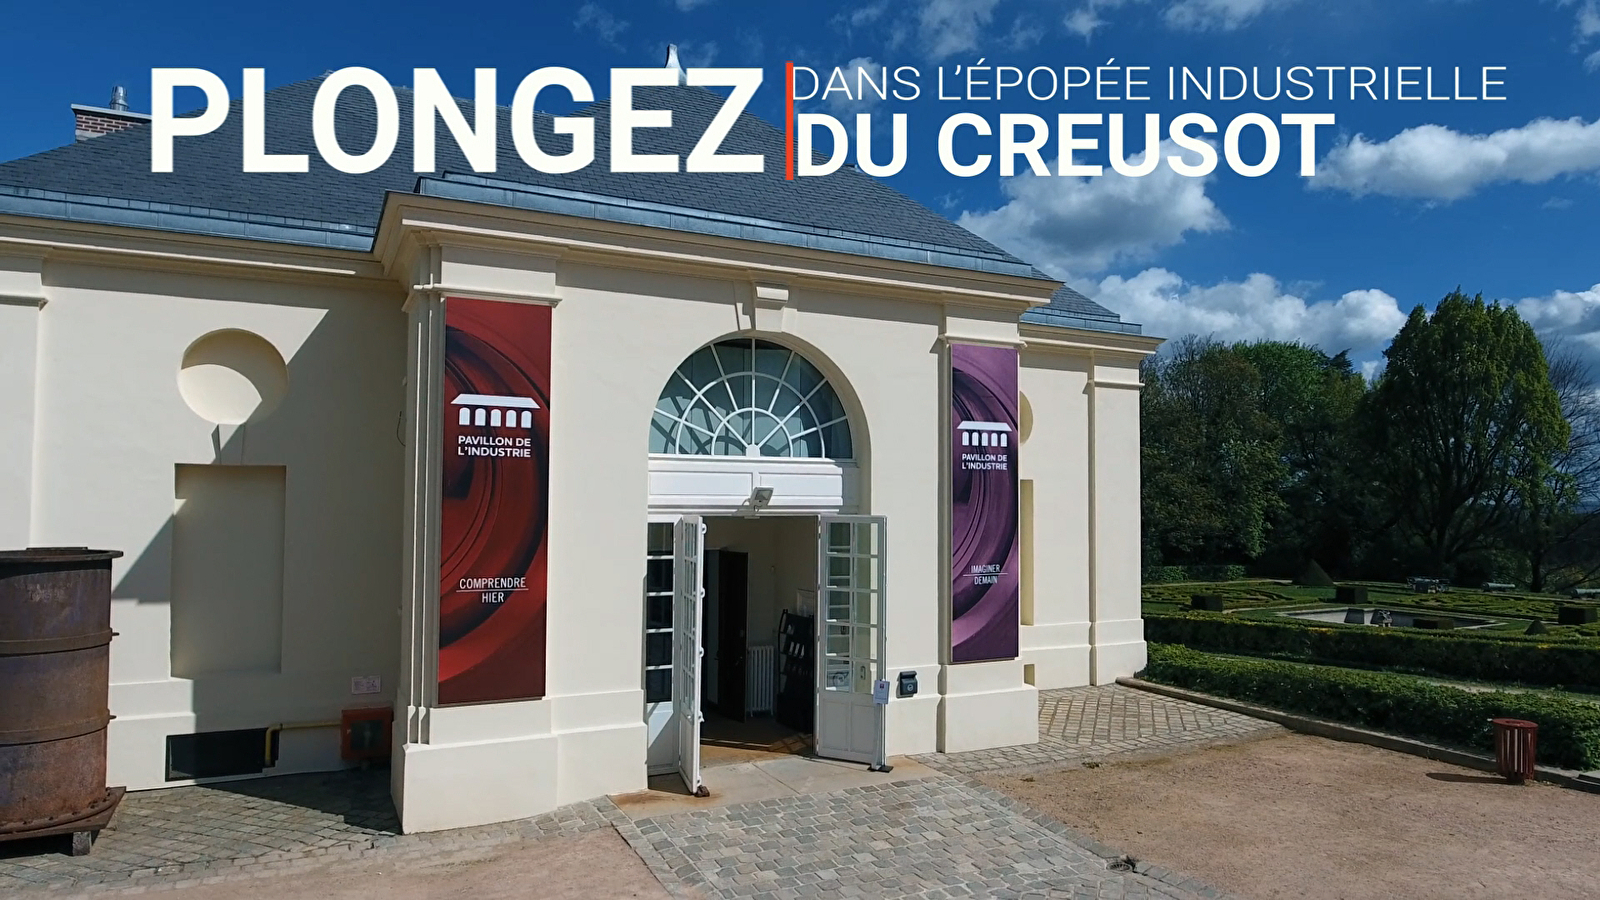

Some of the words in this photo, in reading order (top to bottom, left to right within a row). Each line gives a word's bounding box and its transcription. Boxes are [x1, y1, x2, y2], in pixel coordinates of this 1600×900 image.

[458, 435, 512, 447] PAVILLON
[515, 438, 532, 447] DE
[457, 446, 531, 458] L'INDUSTRIE
[962, 453, 996, 461] PAVILLON
[997, 454, 1008, 462] DE
[961, 462, 1008, 470] L'INDUSTRIE
[971, 564, 1001, 573] IMAGINER
[459, 577, 527, 589] COMPRENDRE
[974, 575, 998, 585] DEMAIN
[481, 592, 505, 603] HIER
